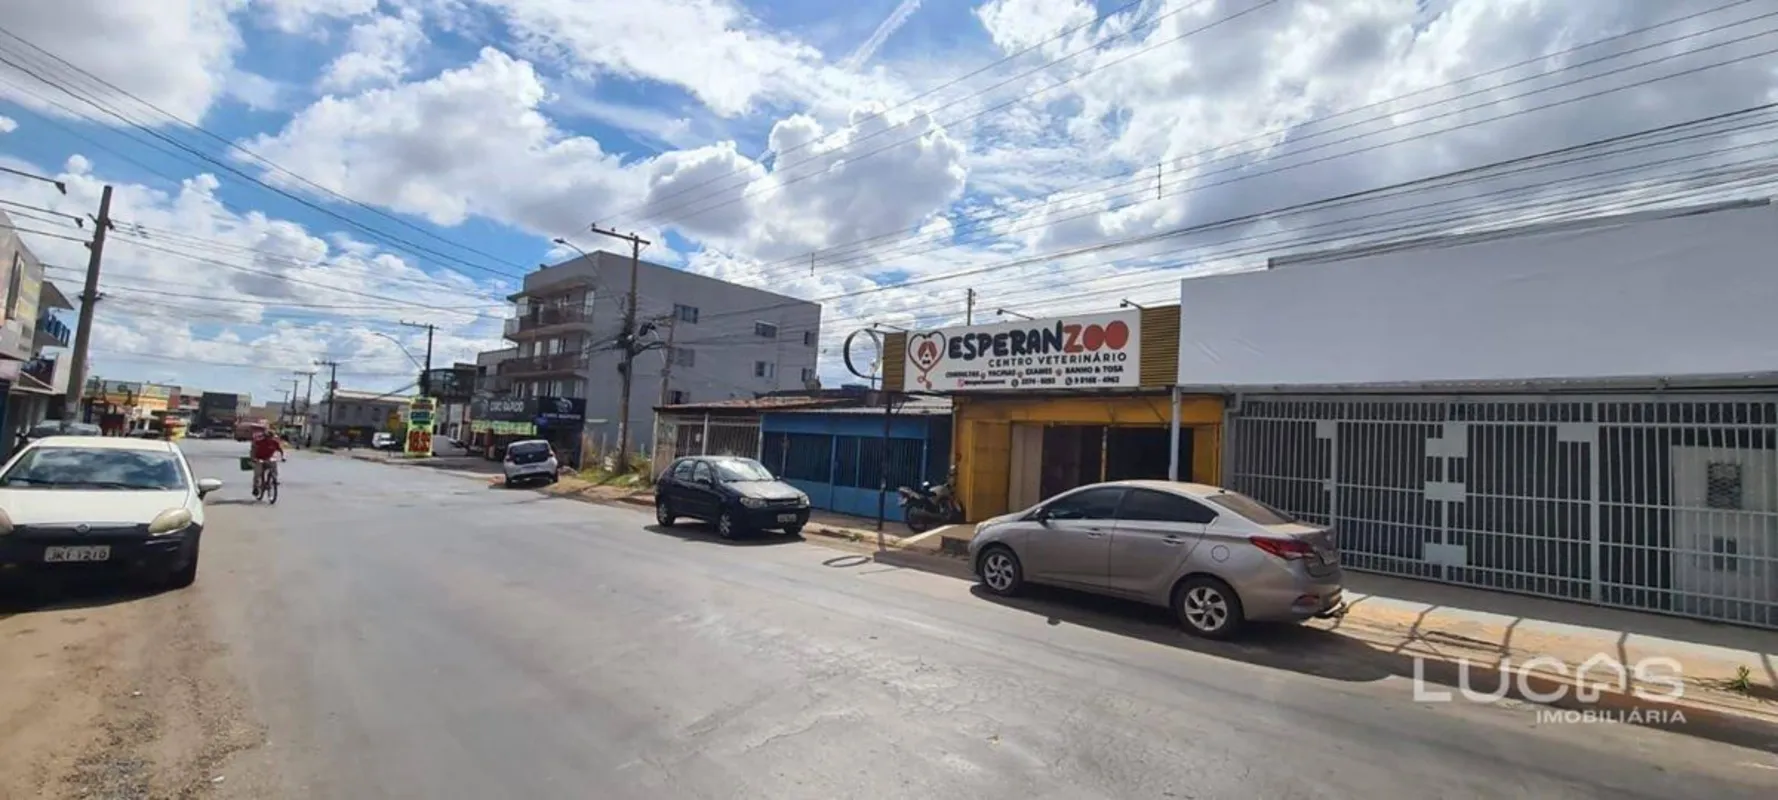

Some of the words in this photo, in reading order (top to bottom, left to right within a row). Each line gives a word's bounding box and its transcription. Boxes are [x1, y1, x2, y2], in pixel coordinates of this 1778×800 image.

[948, 320, 1130, 361] ESPERANZOO
[988, 357, 1033, 368] CENTRO
[1038, 352, 1127, 365] VETERINÁRIO
